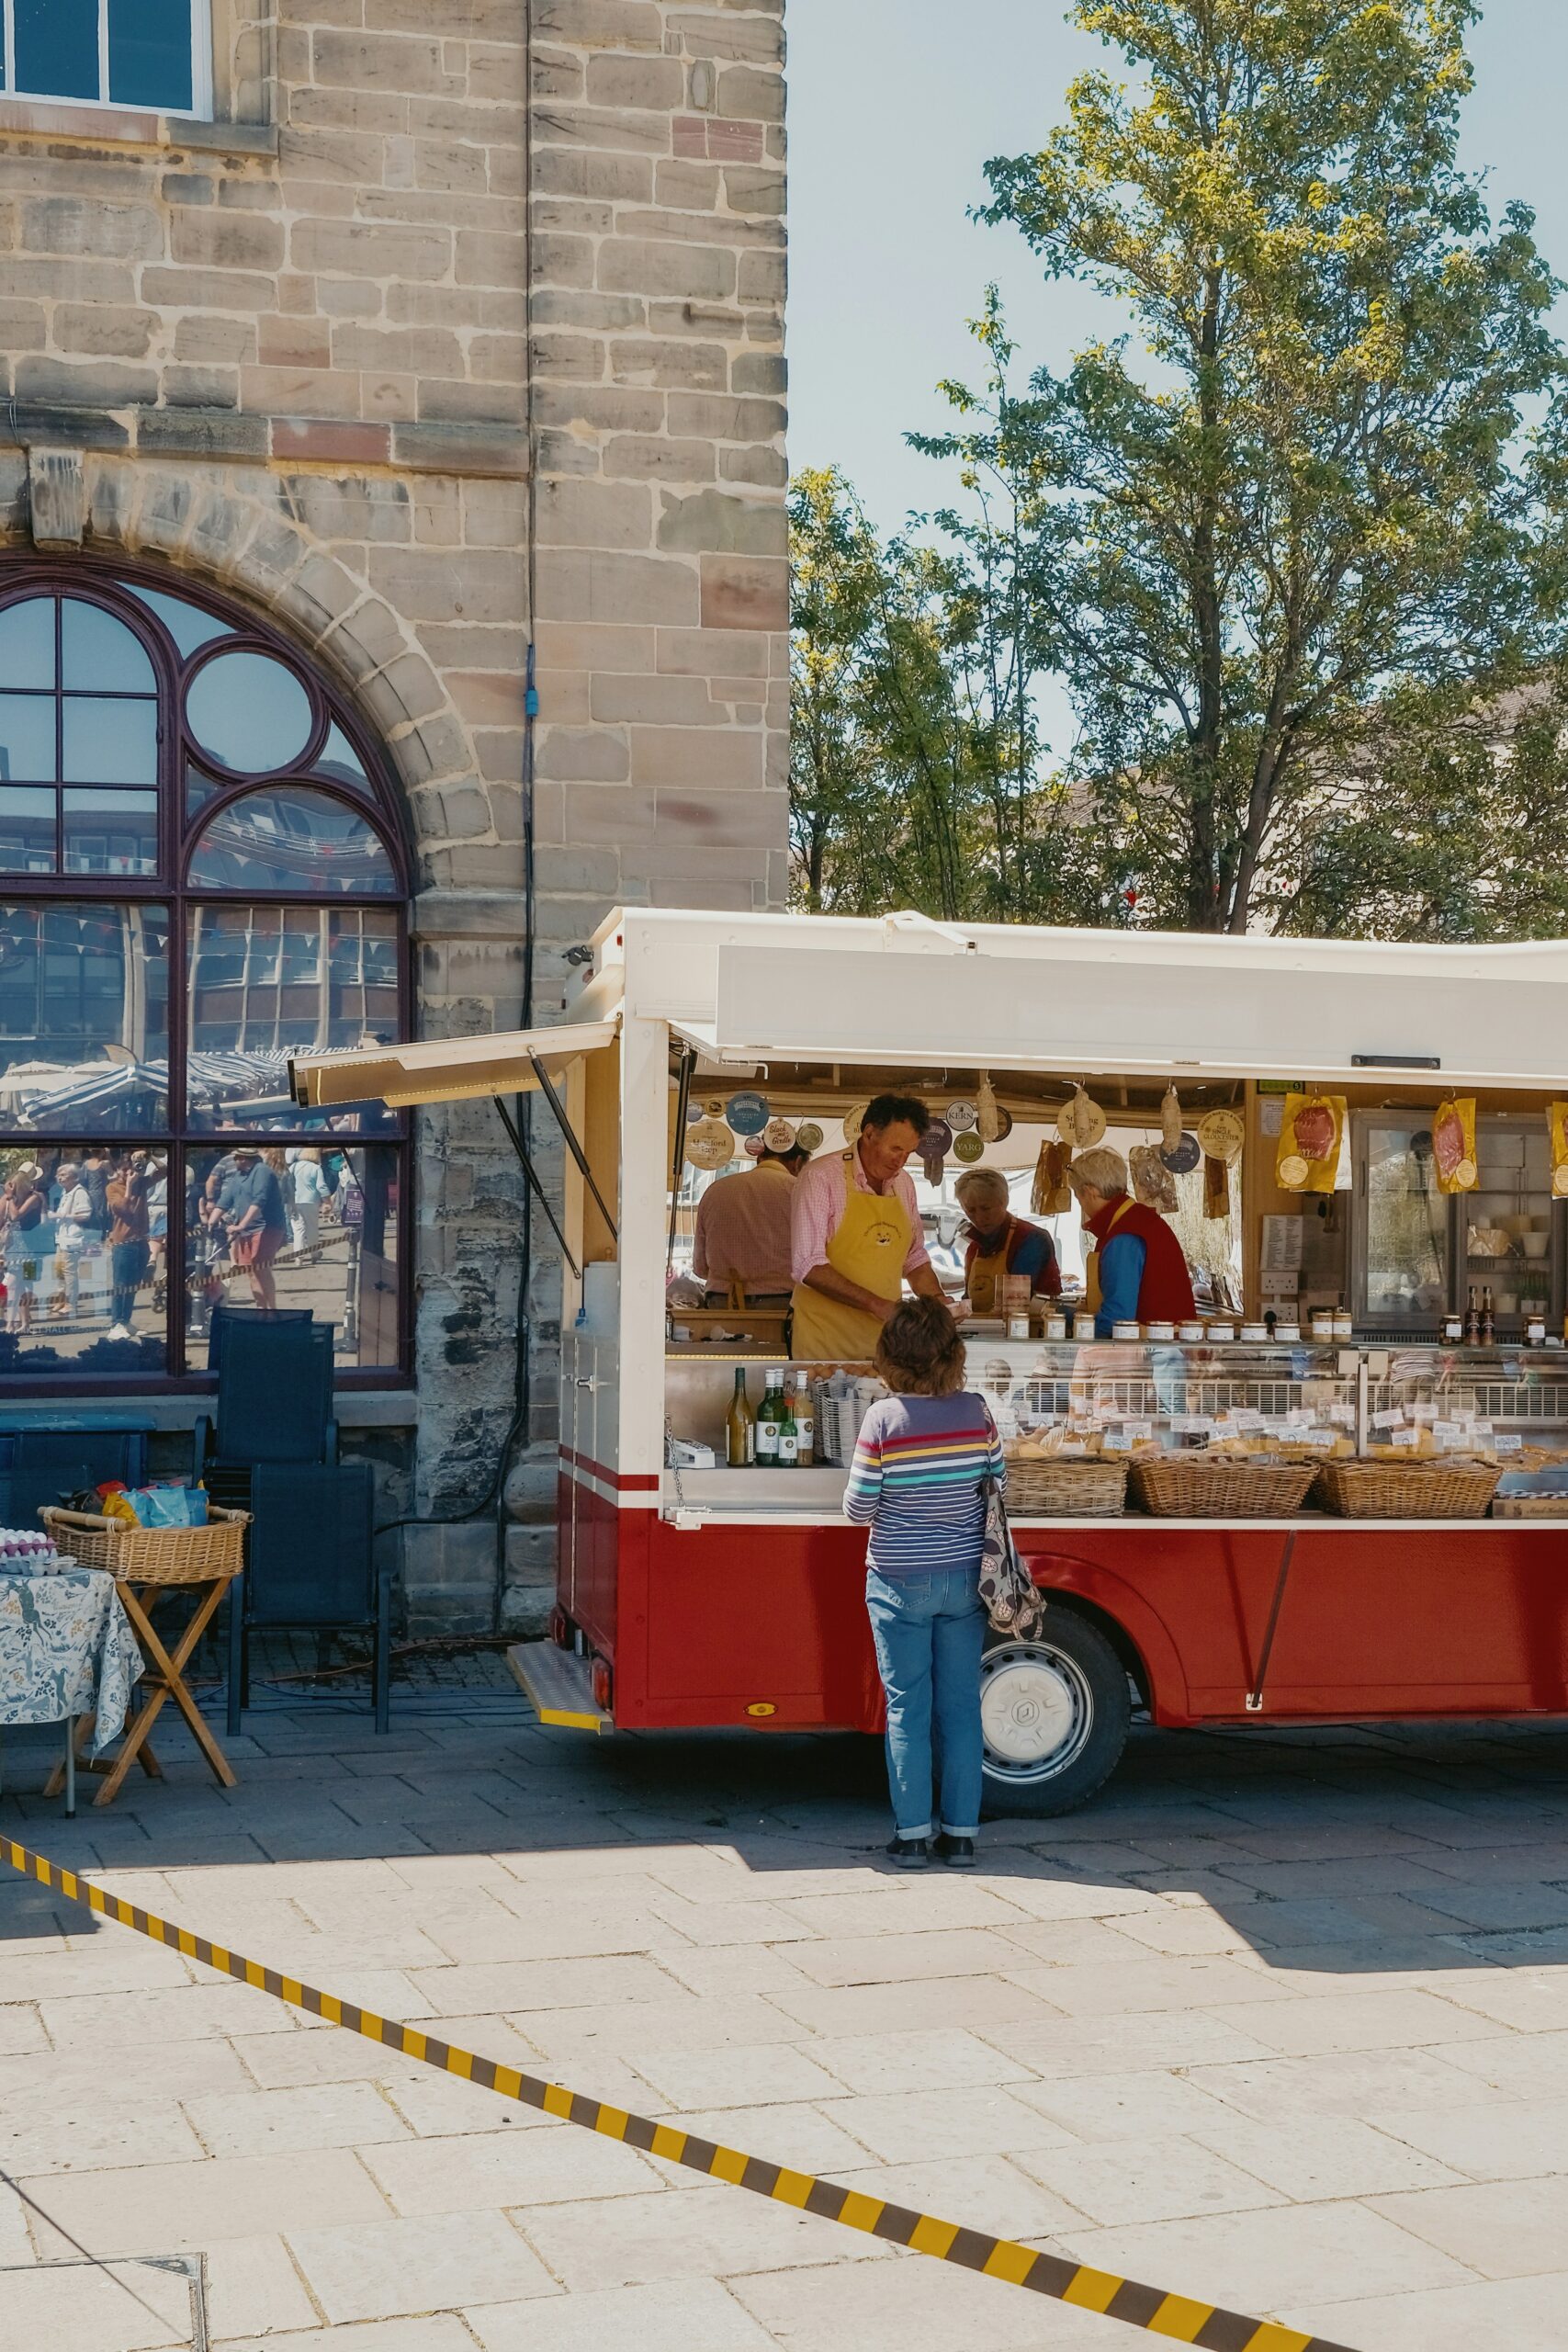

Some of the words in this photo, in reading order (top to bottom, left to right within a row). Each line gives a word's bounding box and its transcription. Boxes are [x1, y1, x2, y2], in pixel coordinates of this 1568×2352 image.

[948, 1112, 974, 1120] KERN
[1066, 1114, 1099, 1125] Stng
[769, 1124, 786, 1134] Slack
[693, 1138, 727, 1147] Hford
[772, 1136, 791, 1145] Girdle
[956, 1143, 982, 1152] YARG
[46, 1325, 67, 1333] HALL
